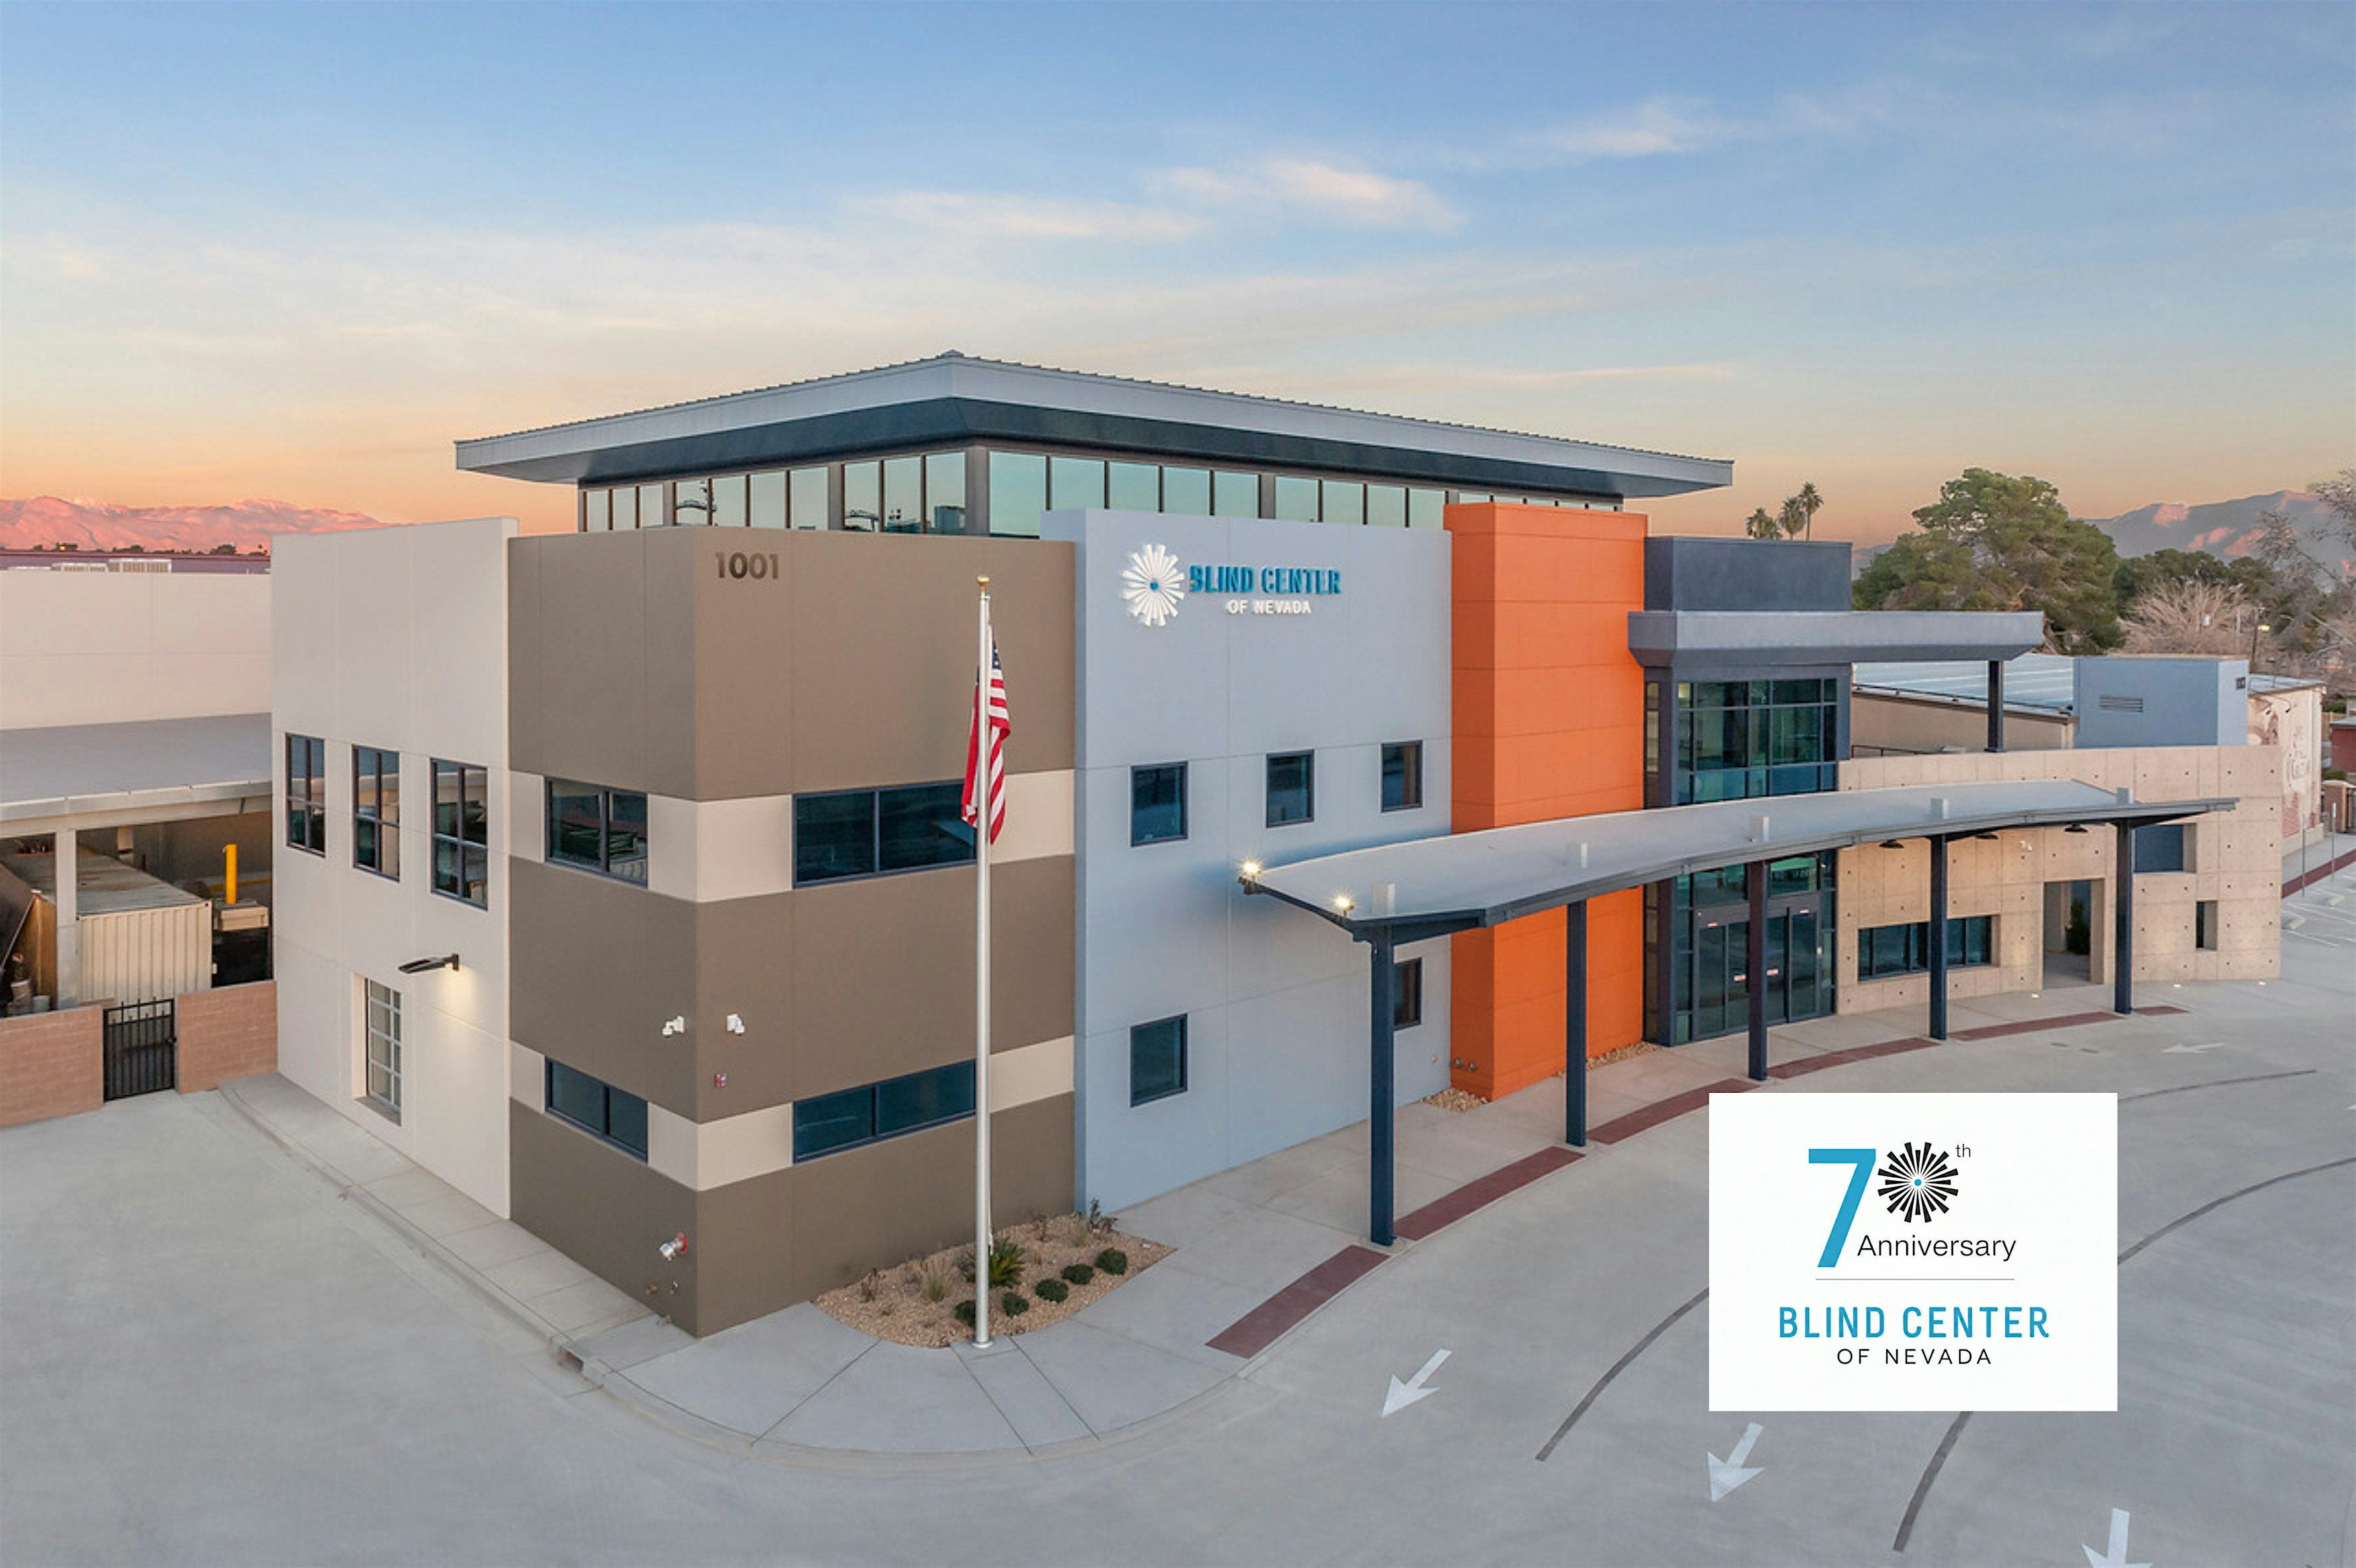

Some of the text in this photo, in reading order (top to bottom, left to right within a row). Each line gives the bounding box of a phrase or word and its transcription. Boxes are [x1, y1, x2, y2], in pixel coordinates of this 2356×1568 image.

[716, 551, 780, 580] 1001
[1189, 565, 1341, 595] BLIND CENTER
[1226, 600, 1311, 615] OF NEVADA
